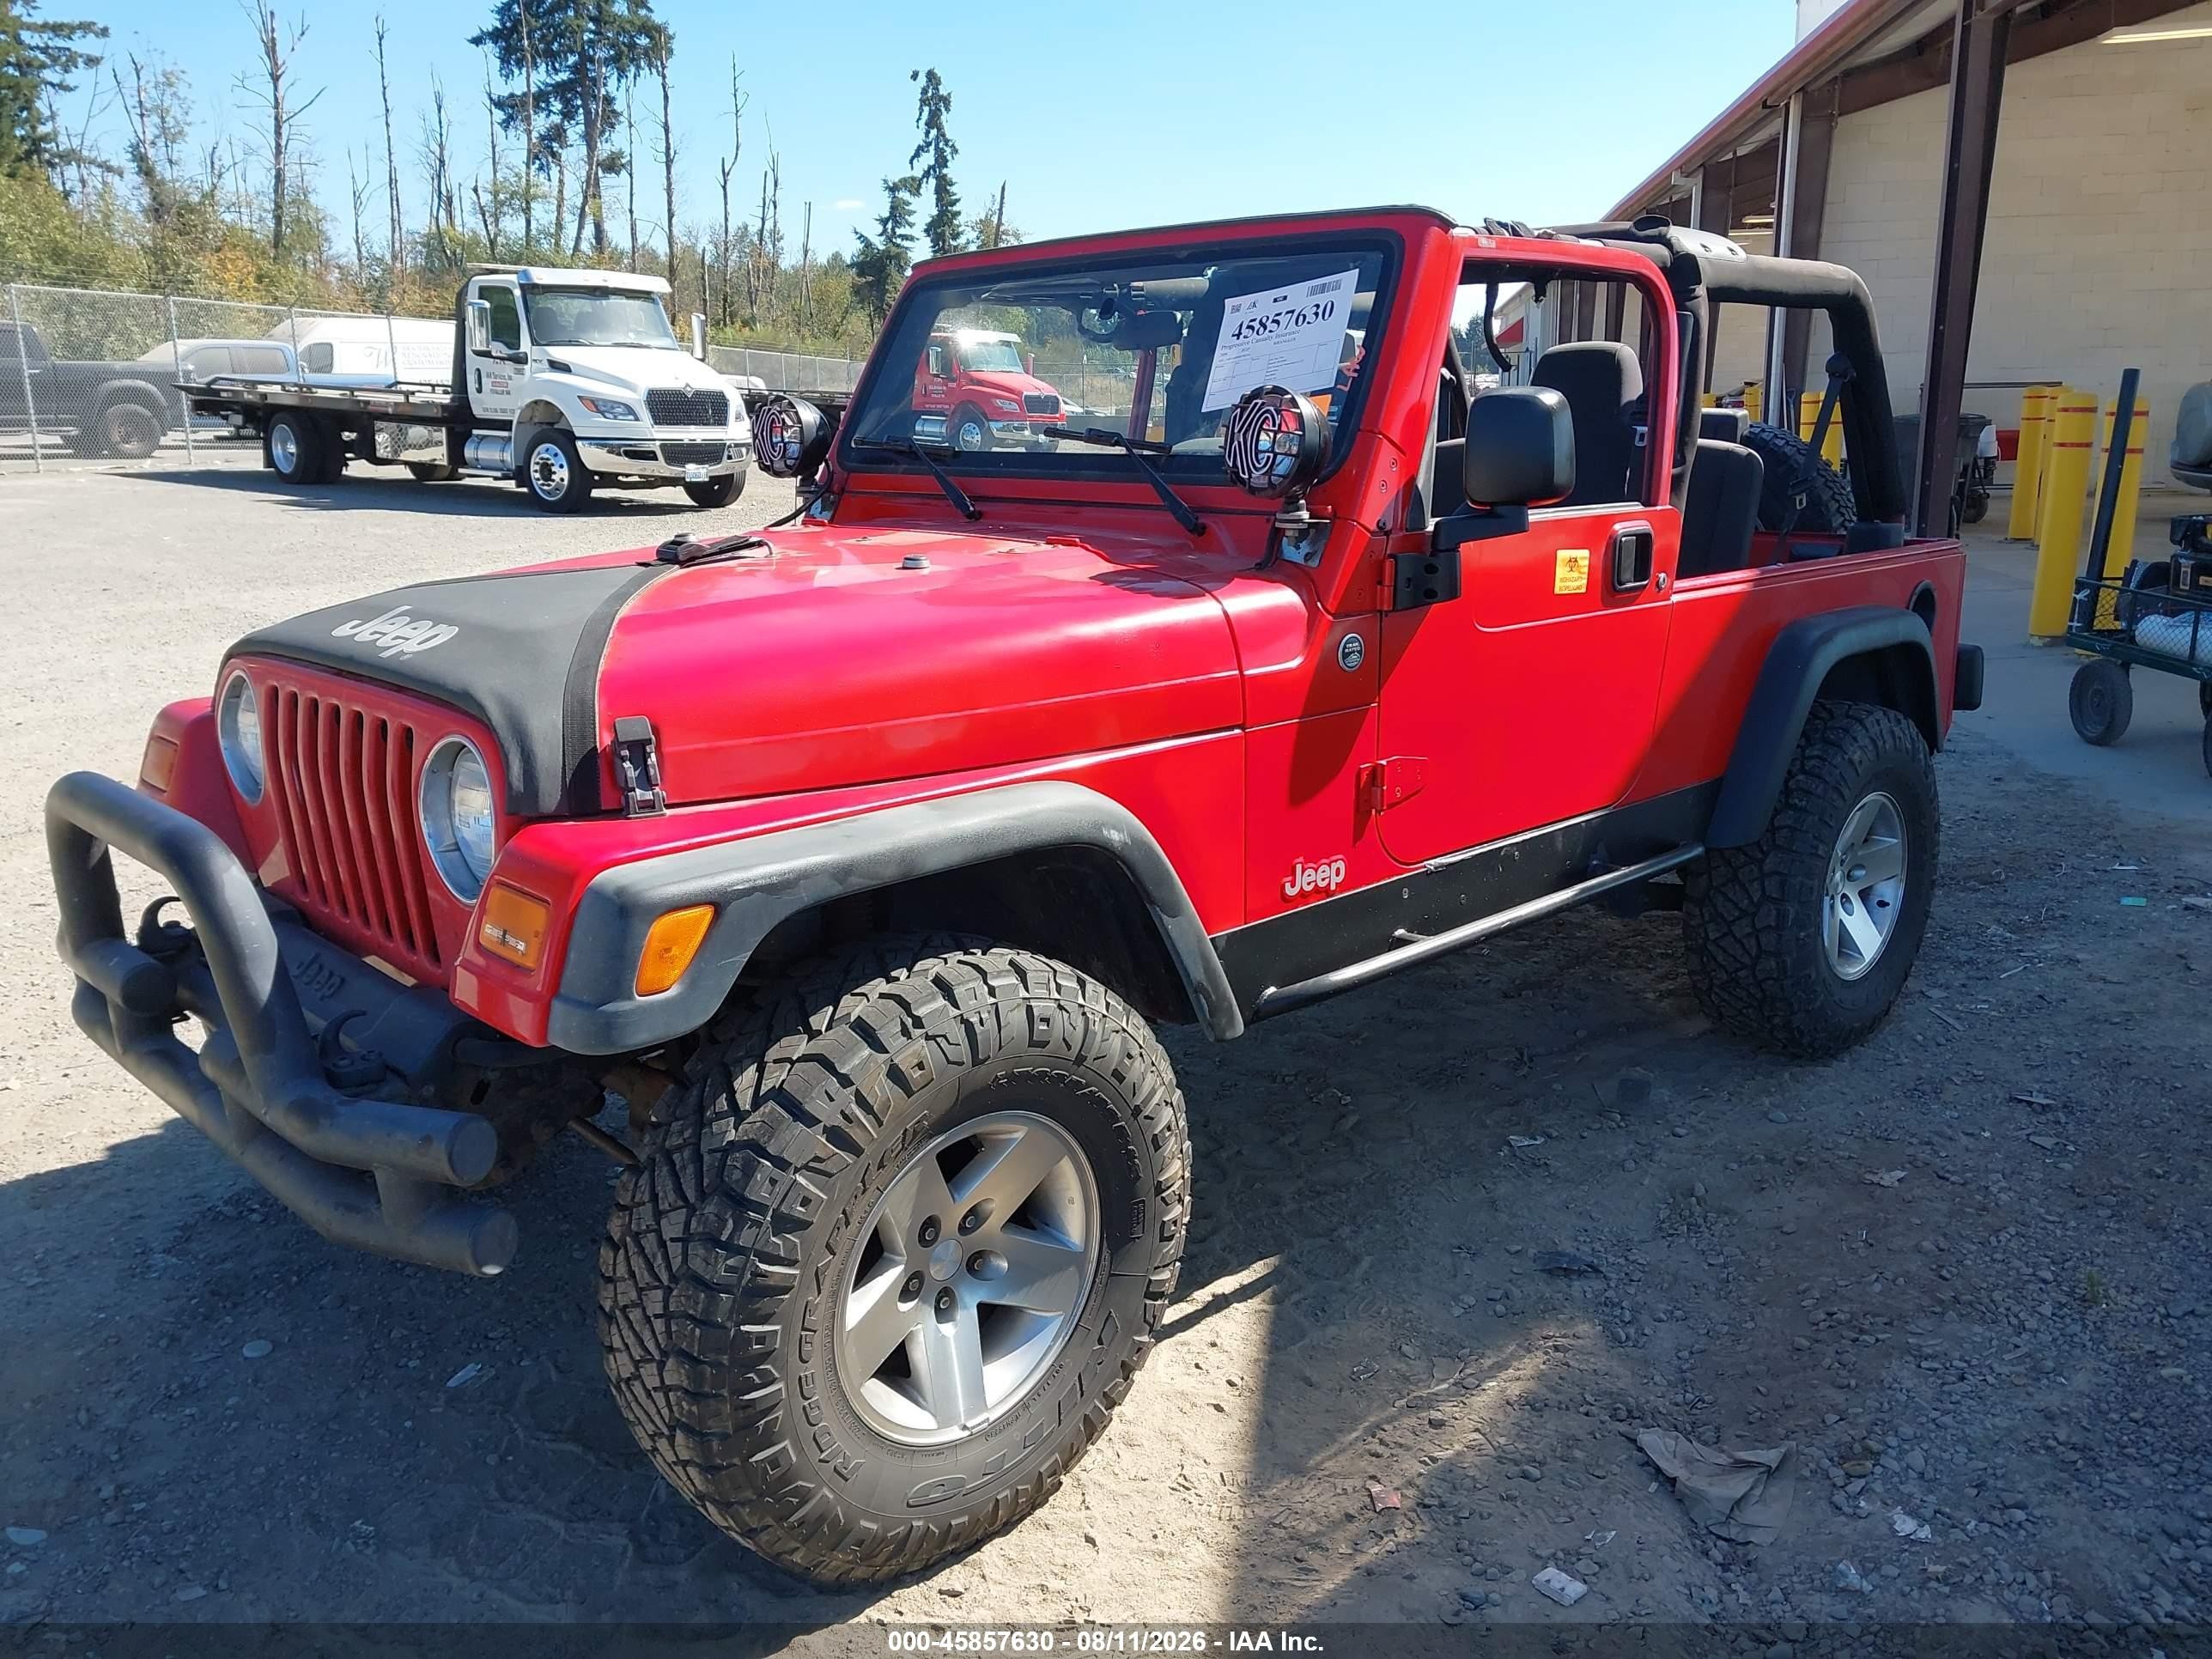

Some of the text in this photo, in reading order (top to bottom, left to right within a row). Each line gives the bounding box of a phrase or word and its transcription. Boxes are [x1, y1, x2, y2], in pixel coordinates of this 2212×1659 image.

[1231, 301, 1334, 340] 45857630
[1251, 336, 1273, 344] Casualty
[1274, 330, 1301, 339] Insurance
[751, 406, 784, 465] KC
[1225, 399, 1278, 478] KC
[331, 605, 459, 659] Jeep
[1284, 860, 1346, 896] Jeep
[293, 952, 345, 1002] Jeep
[798, 1370, 866, 1482] RIDGE
[907, 1309, 1120, 1509] NITTO
